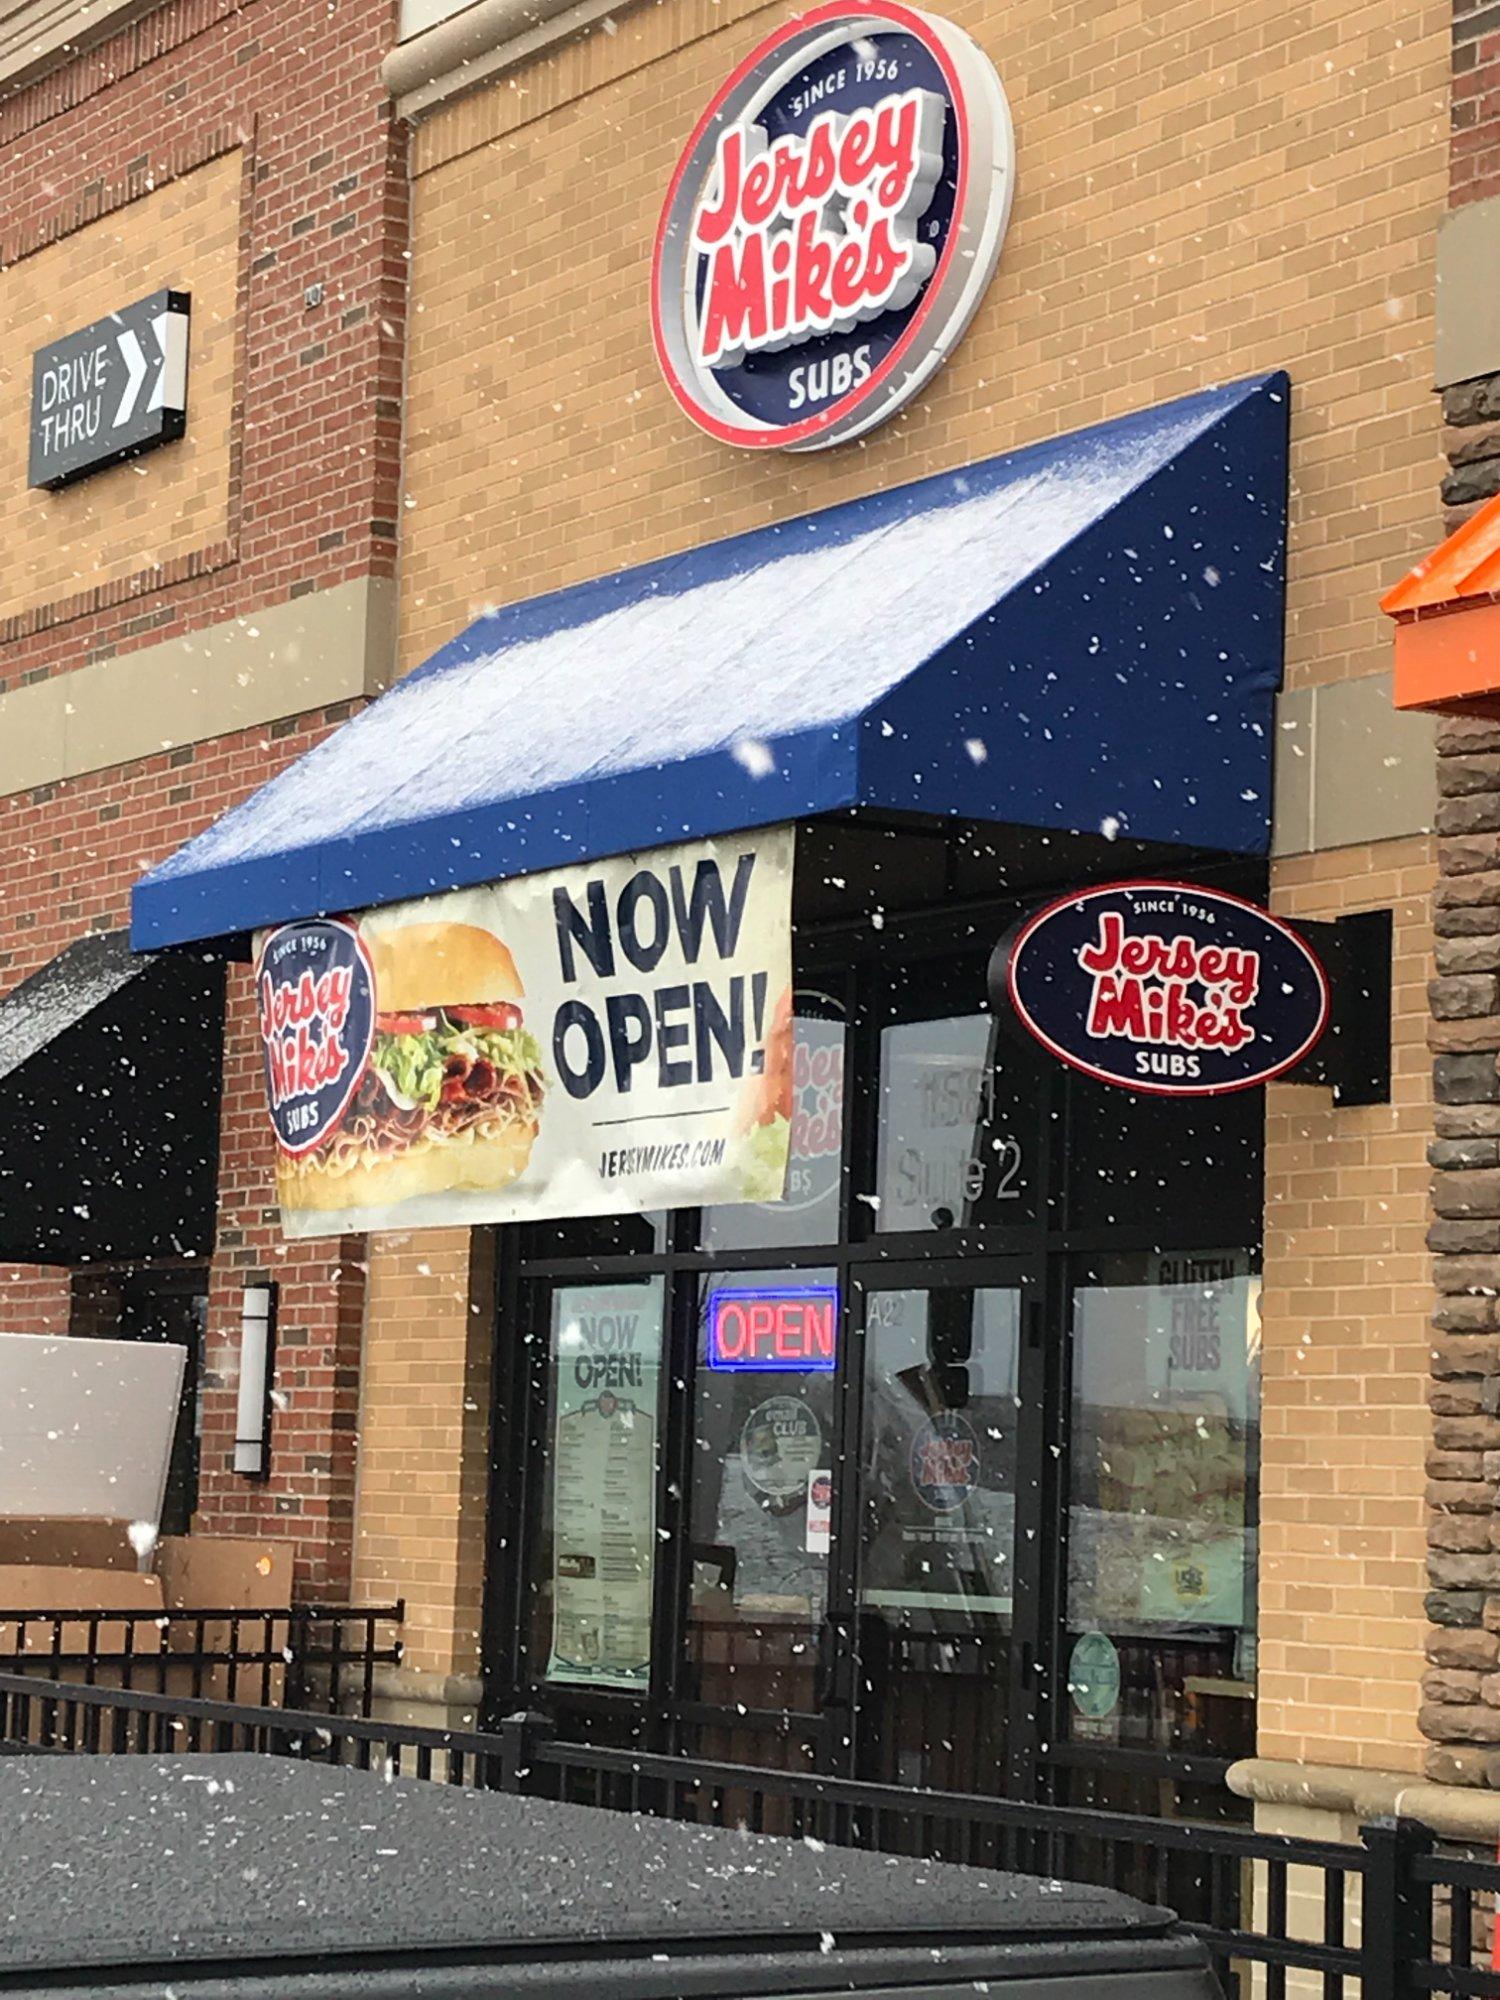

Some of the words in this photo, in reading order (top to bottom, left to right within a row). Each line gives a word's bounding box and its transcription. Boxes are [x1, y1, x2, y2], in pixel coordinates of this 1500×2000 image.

[793, 70, 847, 117] SINCE
[855, 58, 899, 83] 1956
[696, 98, 918, 244] Jersey
[701, 199, 908, 358] Mike's
[41, 344, 108, 412] DRIVE
[788, 345, 872, 410] SUBS
[40, 395, 102, 456] THRU
[552, 853, 757, 982] NOW
[1133, 901, 1176, 914] SINCE
[1181, 903, 1216, 925] 1956
[272, 938, 298, 964] SINCE
[300, 935, 327, 952] 1956
[1080, 915, 1258, 1004] Jersey
[262, 966, 352, 1039] Jersey
[1090, 976, 1254, 1047] Mike's
[552, 972, 769, 1100] OPEN!
[1135, 1051, 1201, 1078] SUBS
[286, 1101, 319, 1135] SUBS
[997, 1140, 1022, 1200] 2
[1158, 1257, 1235, 1297] GLUTEN
[579, 1314, 640, 1353] NOW
[716, 1303, 834, 1359] OPEN
[1171, 1296, 1221, 1333] FREE
[574, 1351, 644, 1390] OPEN!
[1168, 1333, 1222, 1370] SUBS
